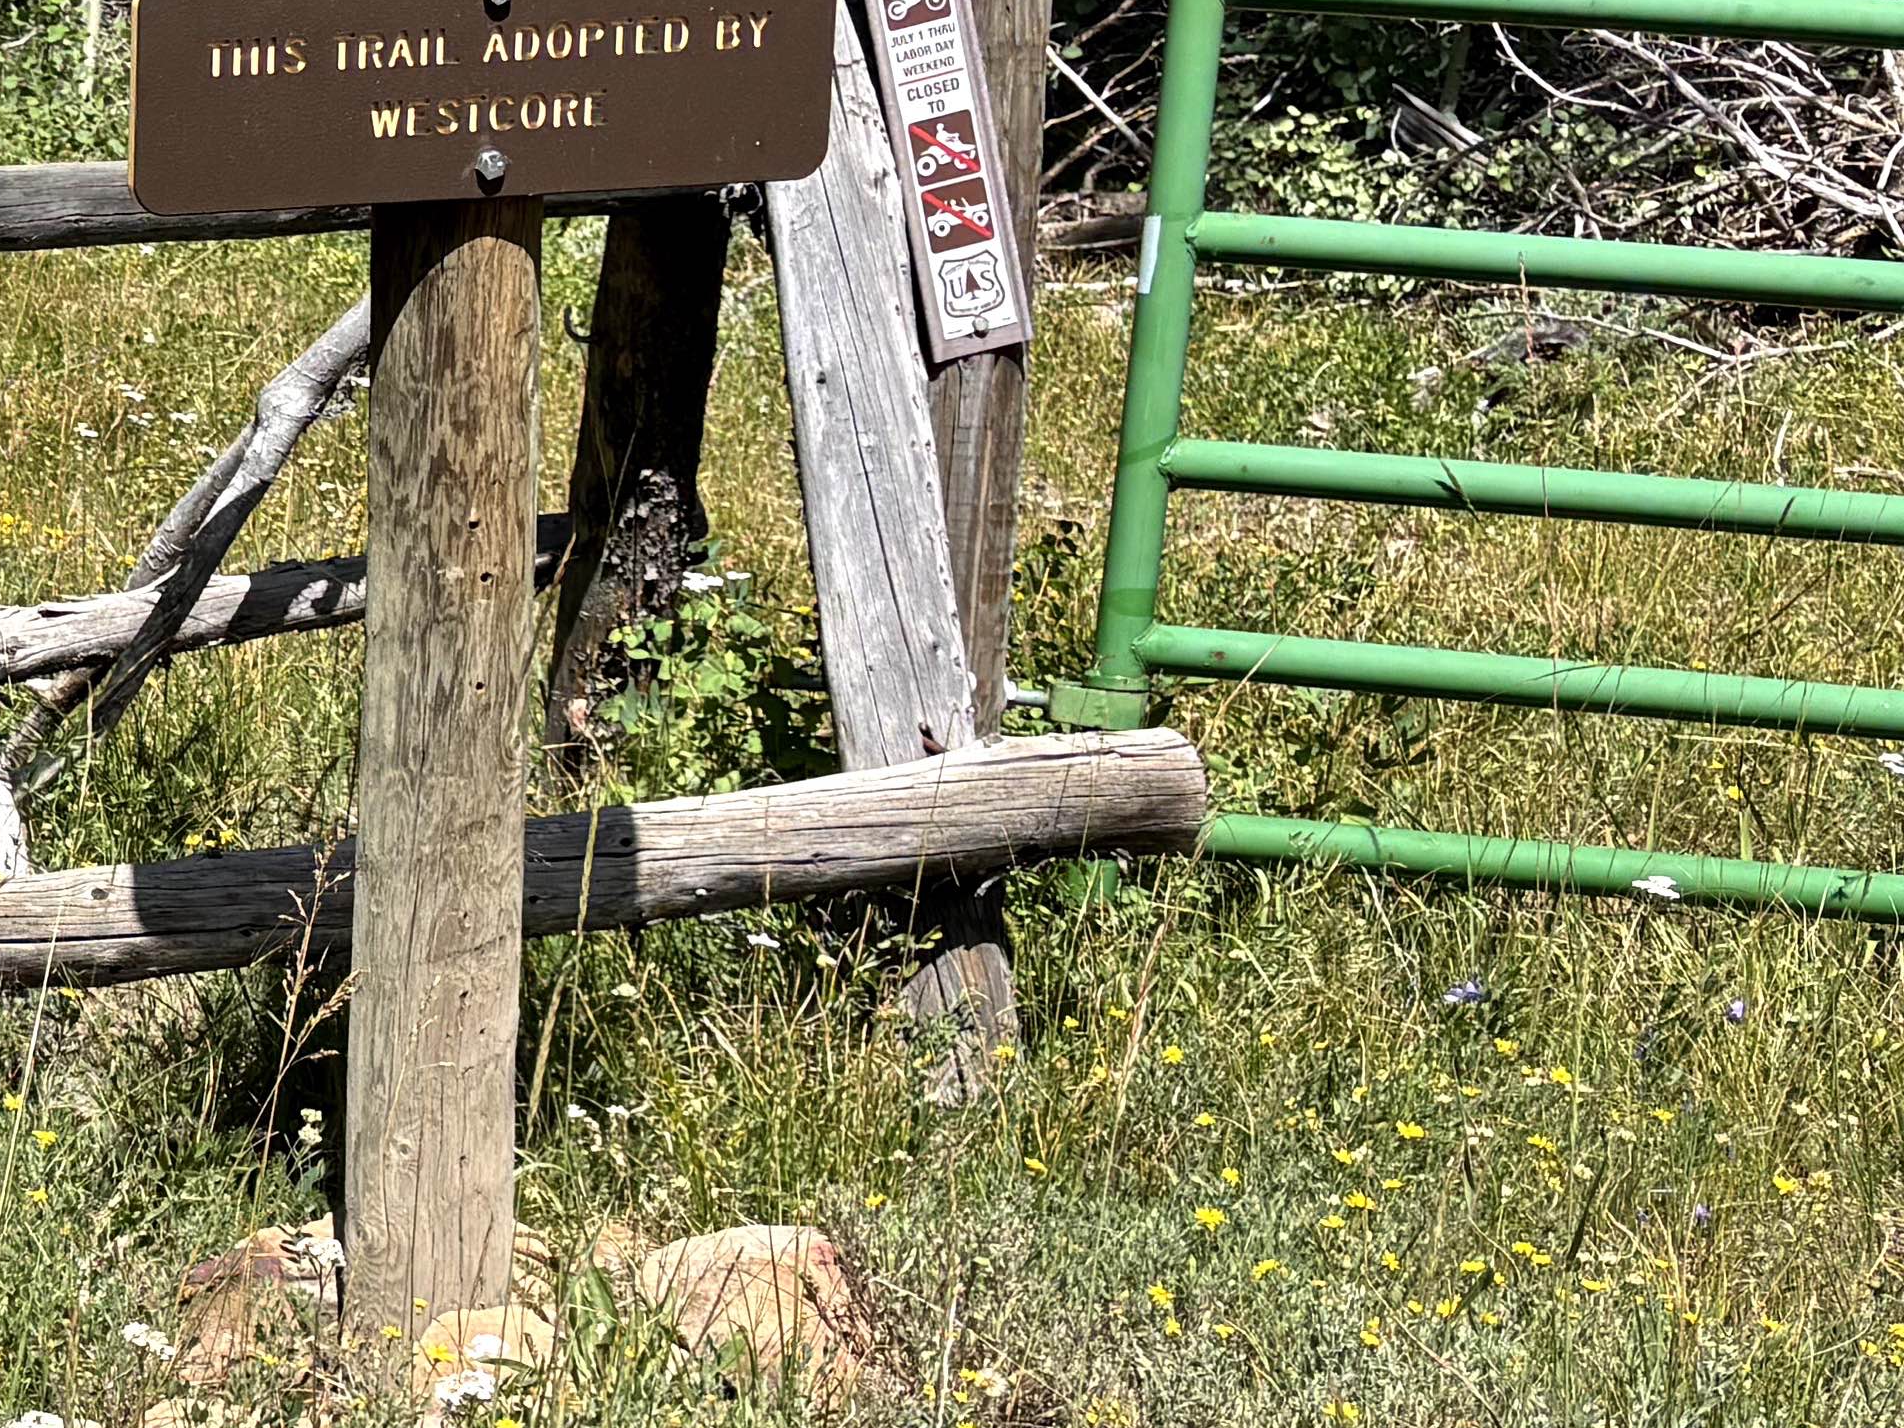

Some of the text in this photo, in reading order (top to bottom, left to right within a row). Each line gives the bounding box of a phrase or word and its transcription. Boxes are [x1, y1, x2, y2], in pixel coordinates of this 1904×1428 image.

[206, 9, 773, 78] THIS TRAIL ADOPTED BY
[890, 22, 956, 49] JULY 1 THRU
[896, 38, 955, 63] LABOR DAY
[903, 56, 955, 78] WEEKEND
[907, 77, 960, 102] CLOSED
[369, 88, 610, 139] WESTCORE
[928, 99, 946, 115] TO
